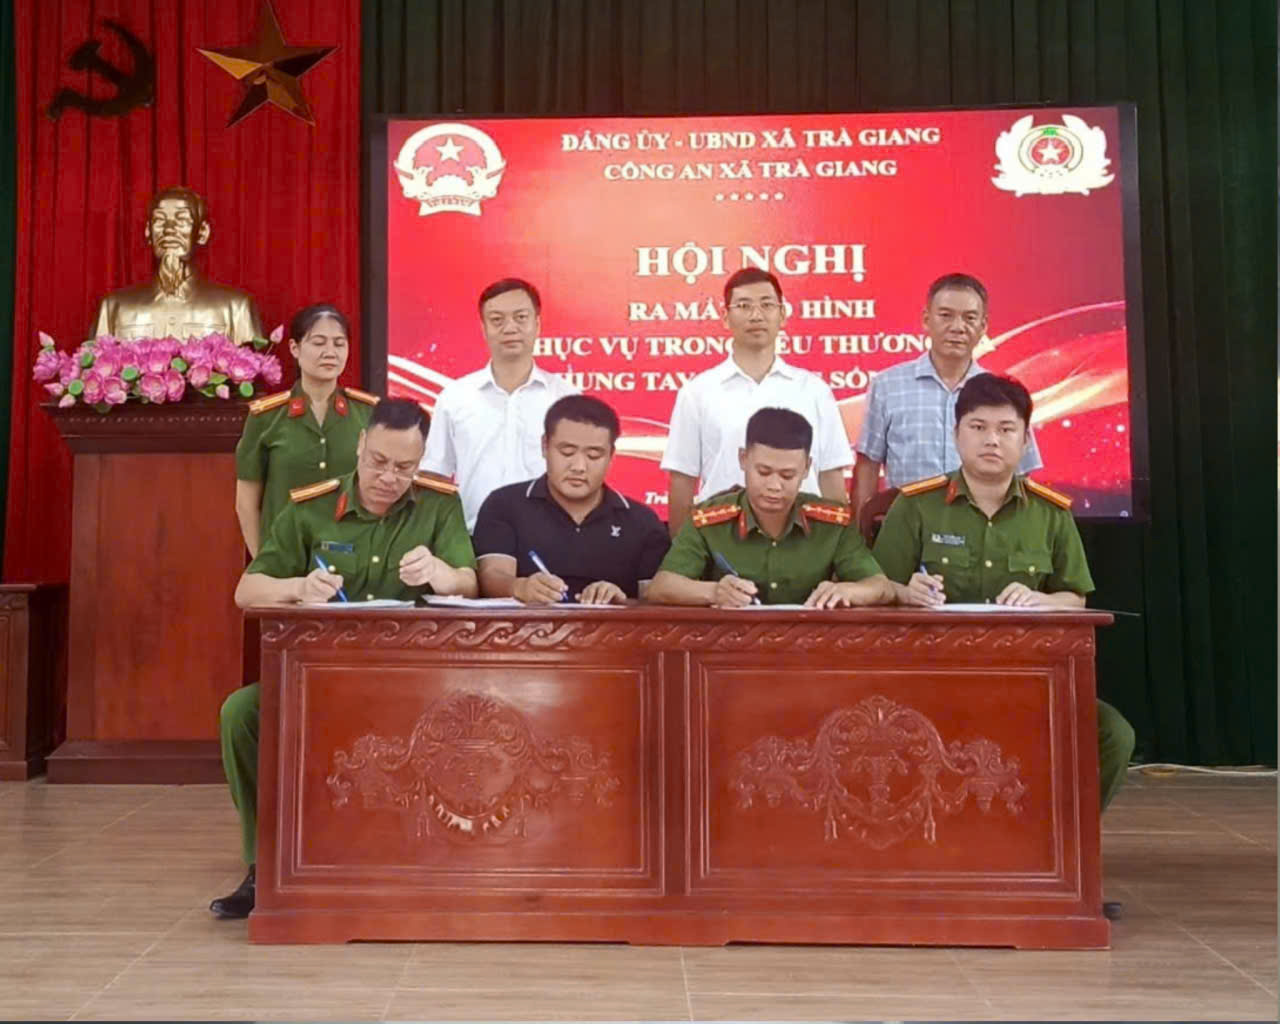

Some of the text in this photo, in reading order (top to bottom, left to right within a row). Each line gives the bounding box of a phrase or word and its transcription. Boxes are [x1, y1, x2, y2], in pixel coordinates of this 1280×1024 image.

[688, 131, 756, 149] UBND
[761, 127, 796, 148] XÃ
[803, 128, 852, 147] TRÀ
[858, 128, 940, 146] GIANG
[603, 157, 898, 180] CÔNG AN XÃ TRÀ GIANG
[635, 242, 866, 284] HỘI NGHỊ
[629, 302, 667, 321] RA
[802, 296, 875, 318] HÌNH
[532, 336, 592, 360] HỤC
[600, 337, 639, 360] VỤ
[775, 330, 812, 354] ÊU
